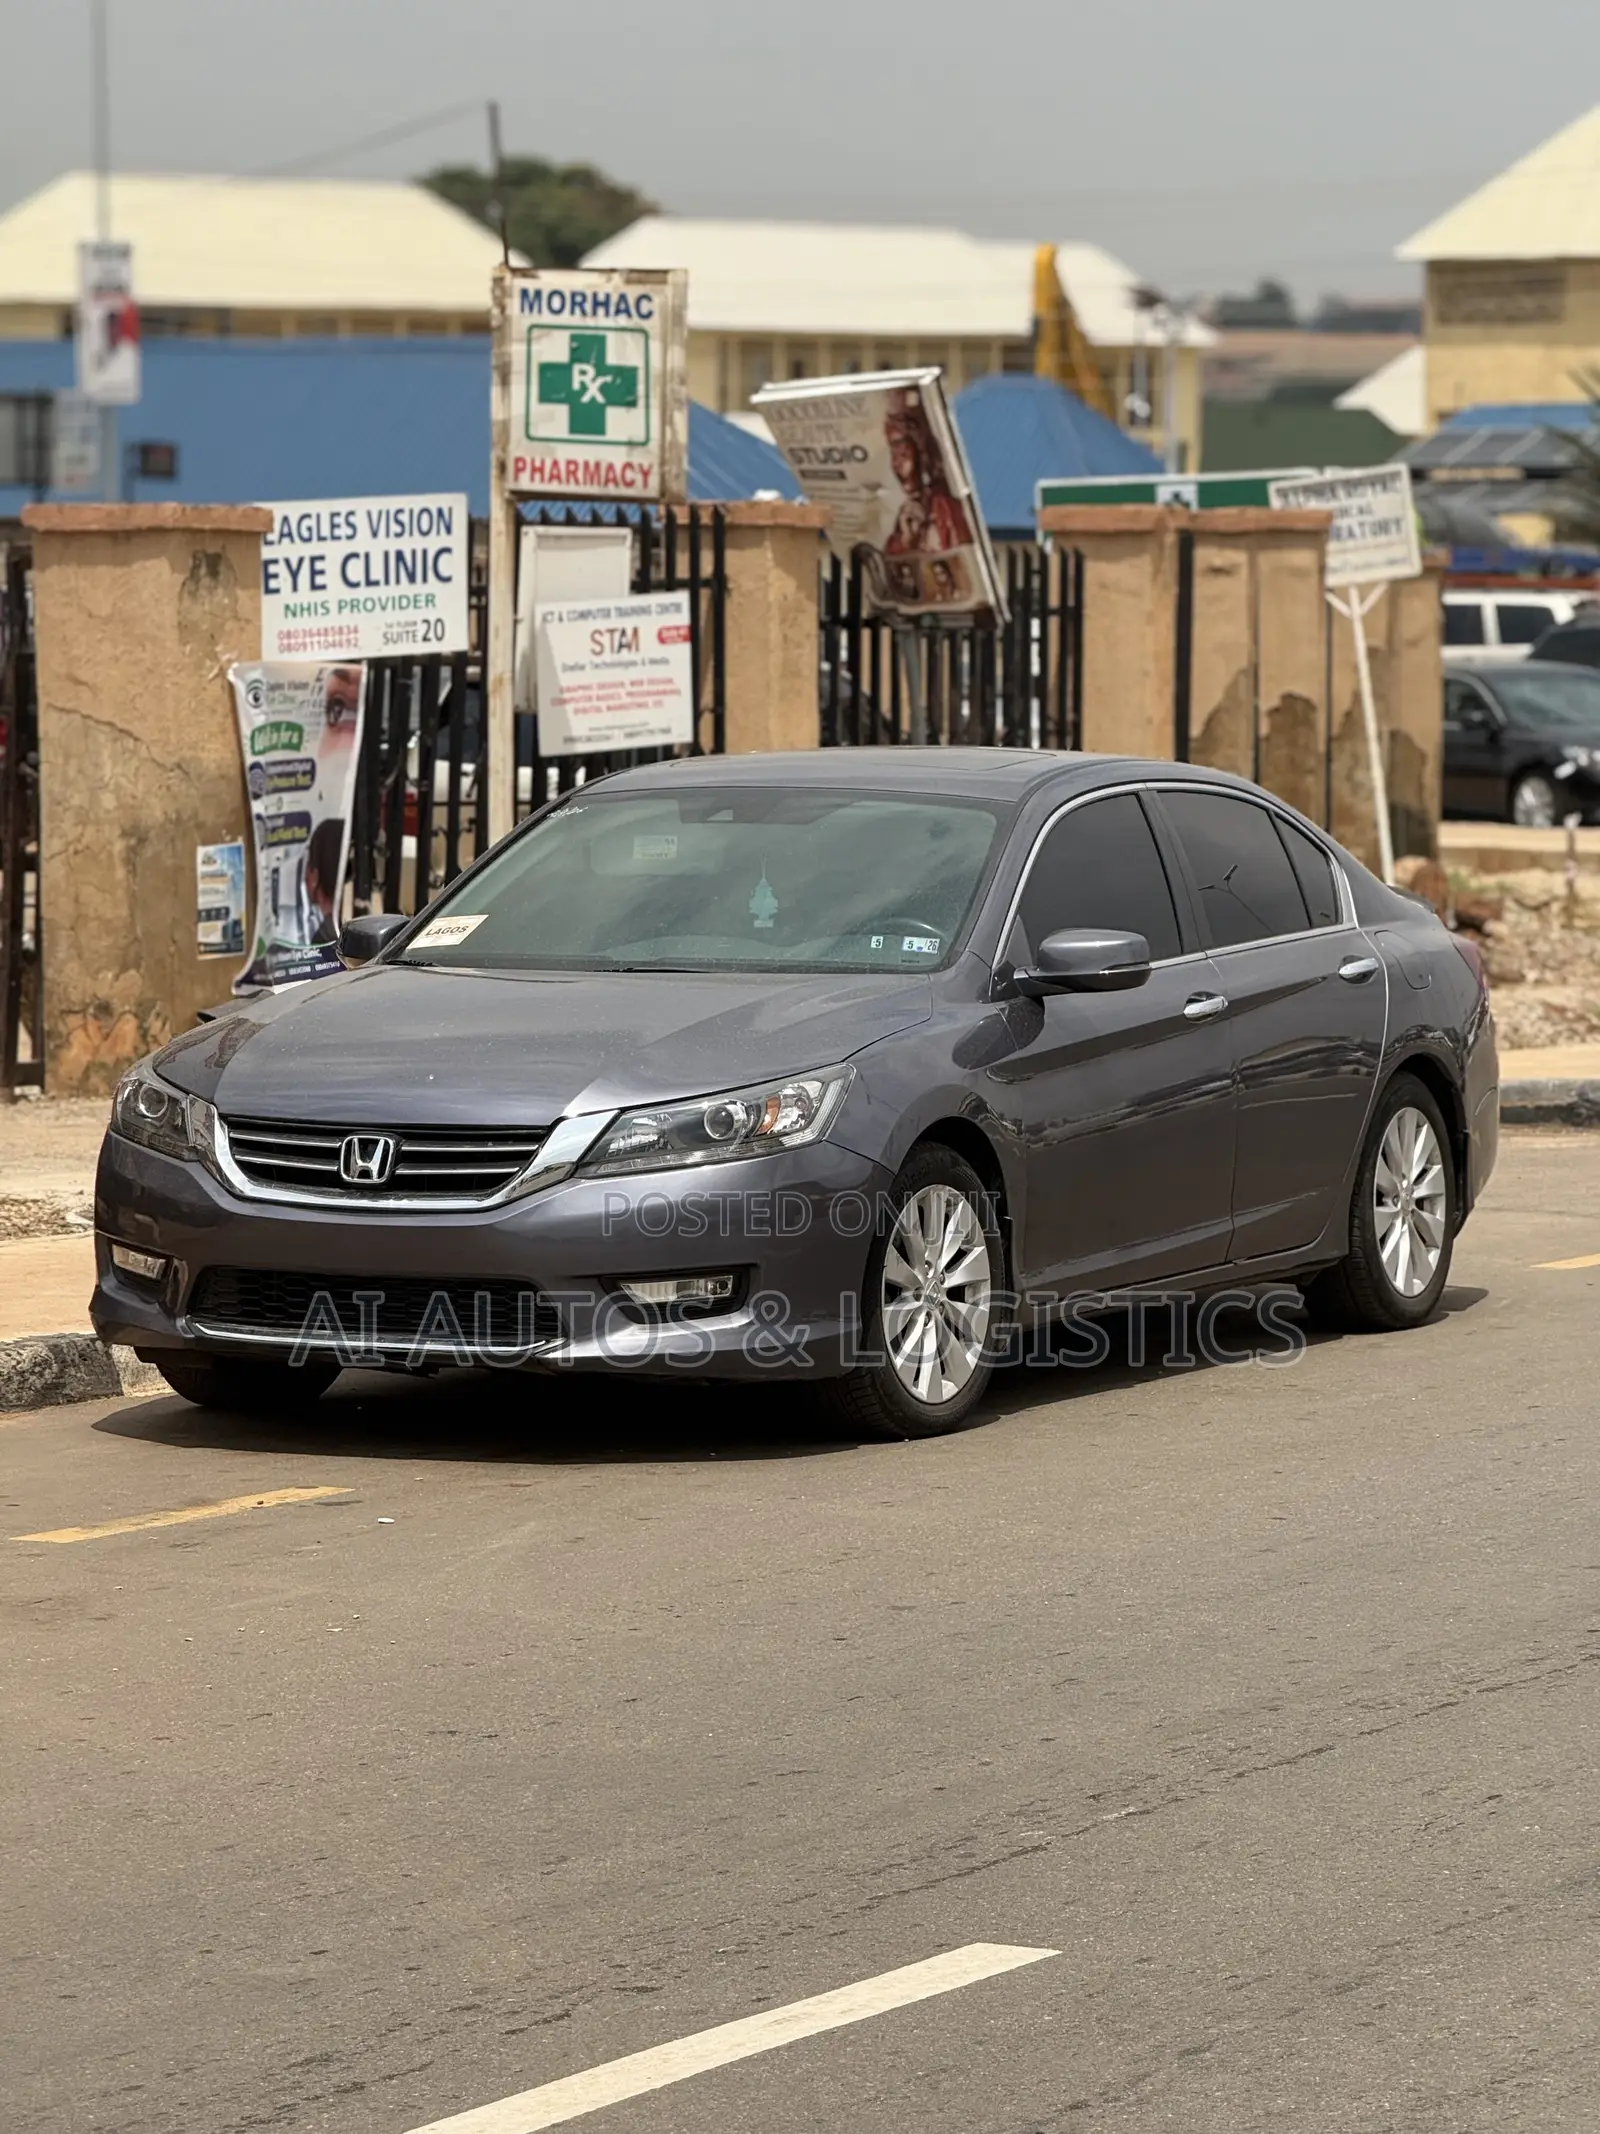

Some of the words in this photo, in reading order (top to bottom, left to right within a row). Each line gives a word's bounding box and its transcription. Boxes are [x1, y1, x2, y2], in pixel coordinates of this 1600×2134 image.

[519, 288, 654, 320] MORHAC
[572, 363, 613, 404] Rx
[788, 445, 868, 465] STUDIO
[513, 457, 653, 489] PHARMACY
[367, 506, 453, 539] VISION
[263, 555, 327, 595] EYE
[340, 547, 453, 589] CLINIC
[284, 600, 330, 619] NHIS
[338, 593, 436, 615] PROVIDER
[383, 629, 418, 645] SUITE
[421, 618, 445, 642] 20
[425, 925, 469, 936] LAGOS
